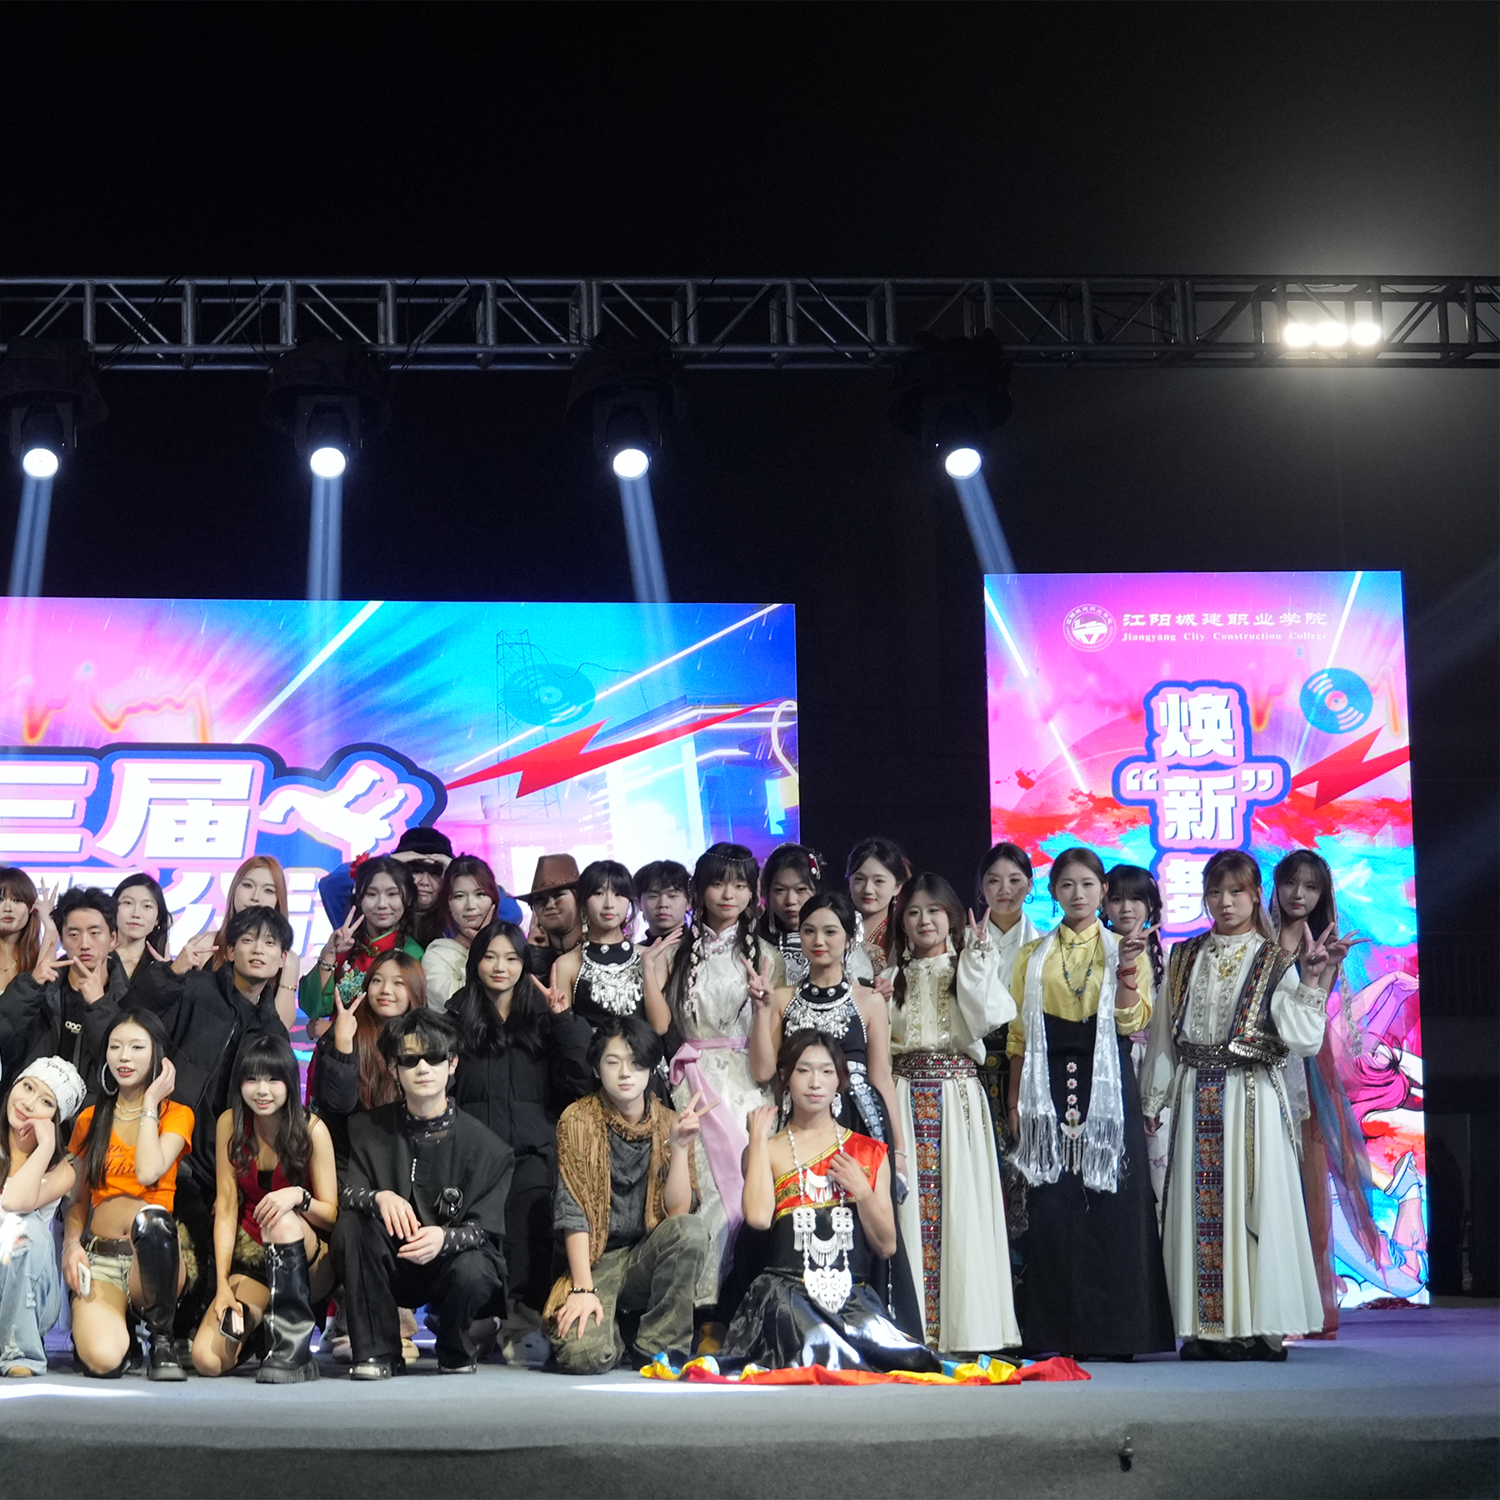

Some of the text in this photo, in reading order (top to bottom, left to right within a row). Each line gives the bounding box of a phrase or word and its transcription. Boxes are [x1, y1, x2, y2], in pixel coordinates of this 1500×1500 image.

[1122, 611, 1328, 628] 江阳城建职业学院
[1121, 630, 1328, 643] Jiangyang City Construction College
